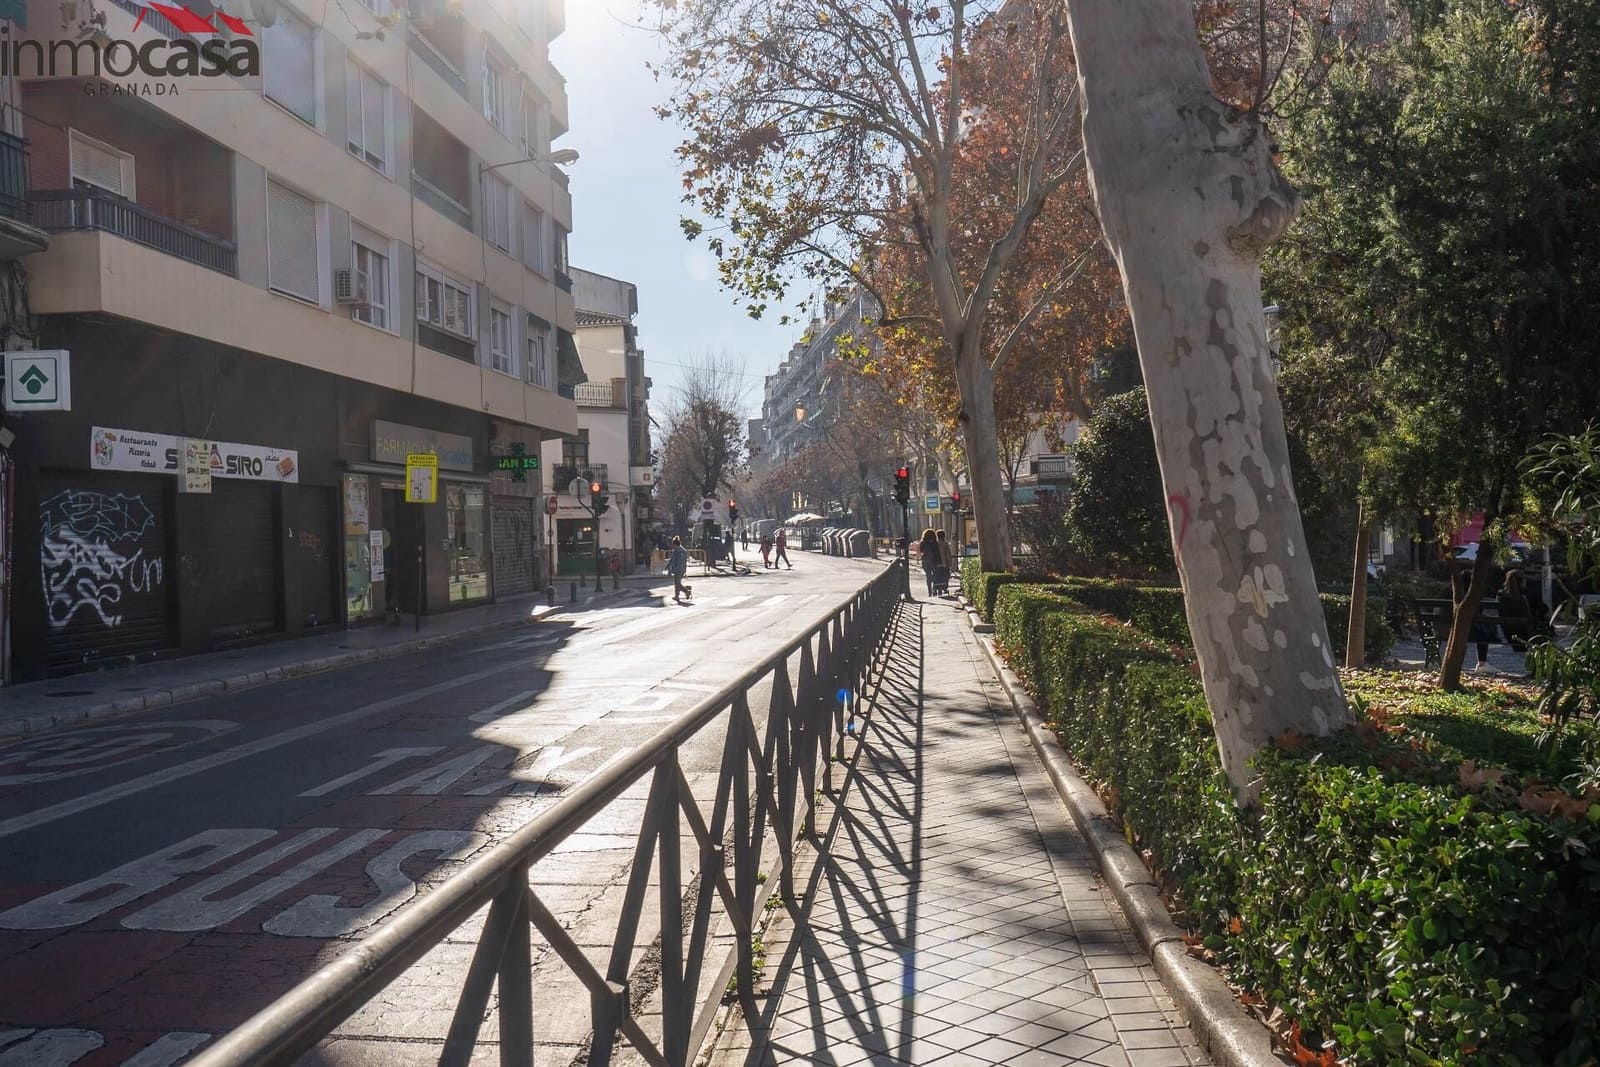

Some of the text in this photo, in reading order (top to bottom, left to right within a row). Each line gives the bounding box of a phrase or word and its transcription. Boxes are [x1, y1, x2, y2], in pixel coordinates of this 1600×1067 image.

[120, 435, 158, 447] Restaurante
[225, 454, 262, 477] SIRO
[303, 745, 638, 797] TAXI
[0, 828, 494, 938] BUS
